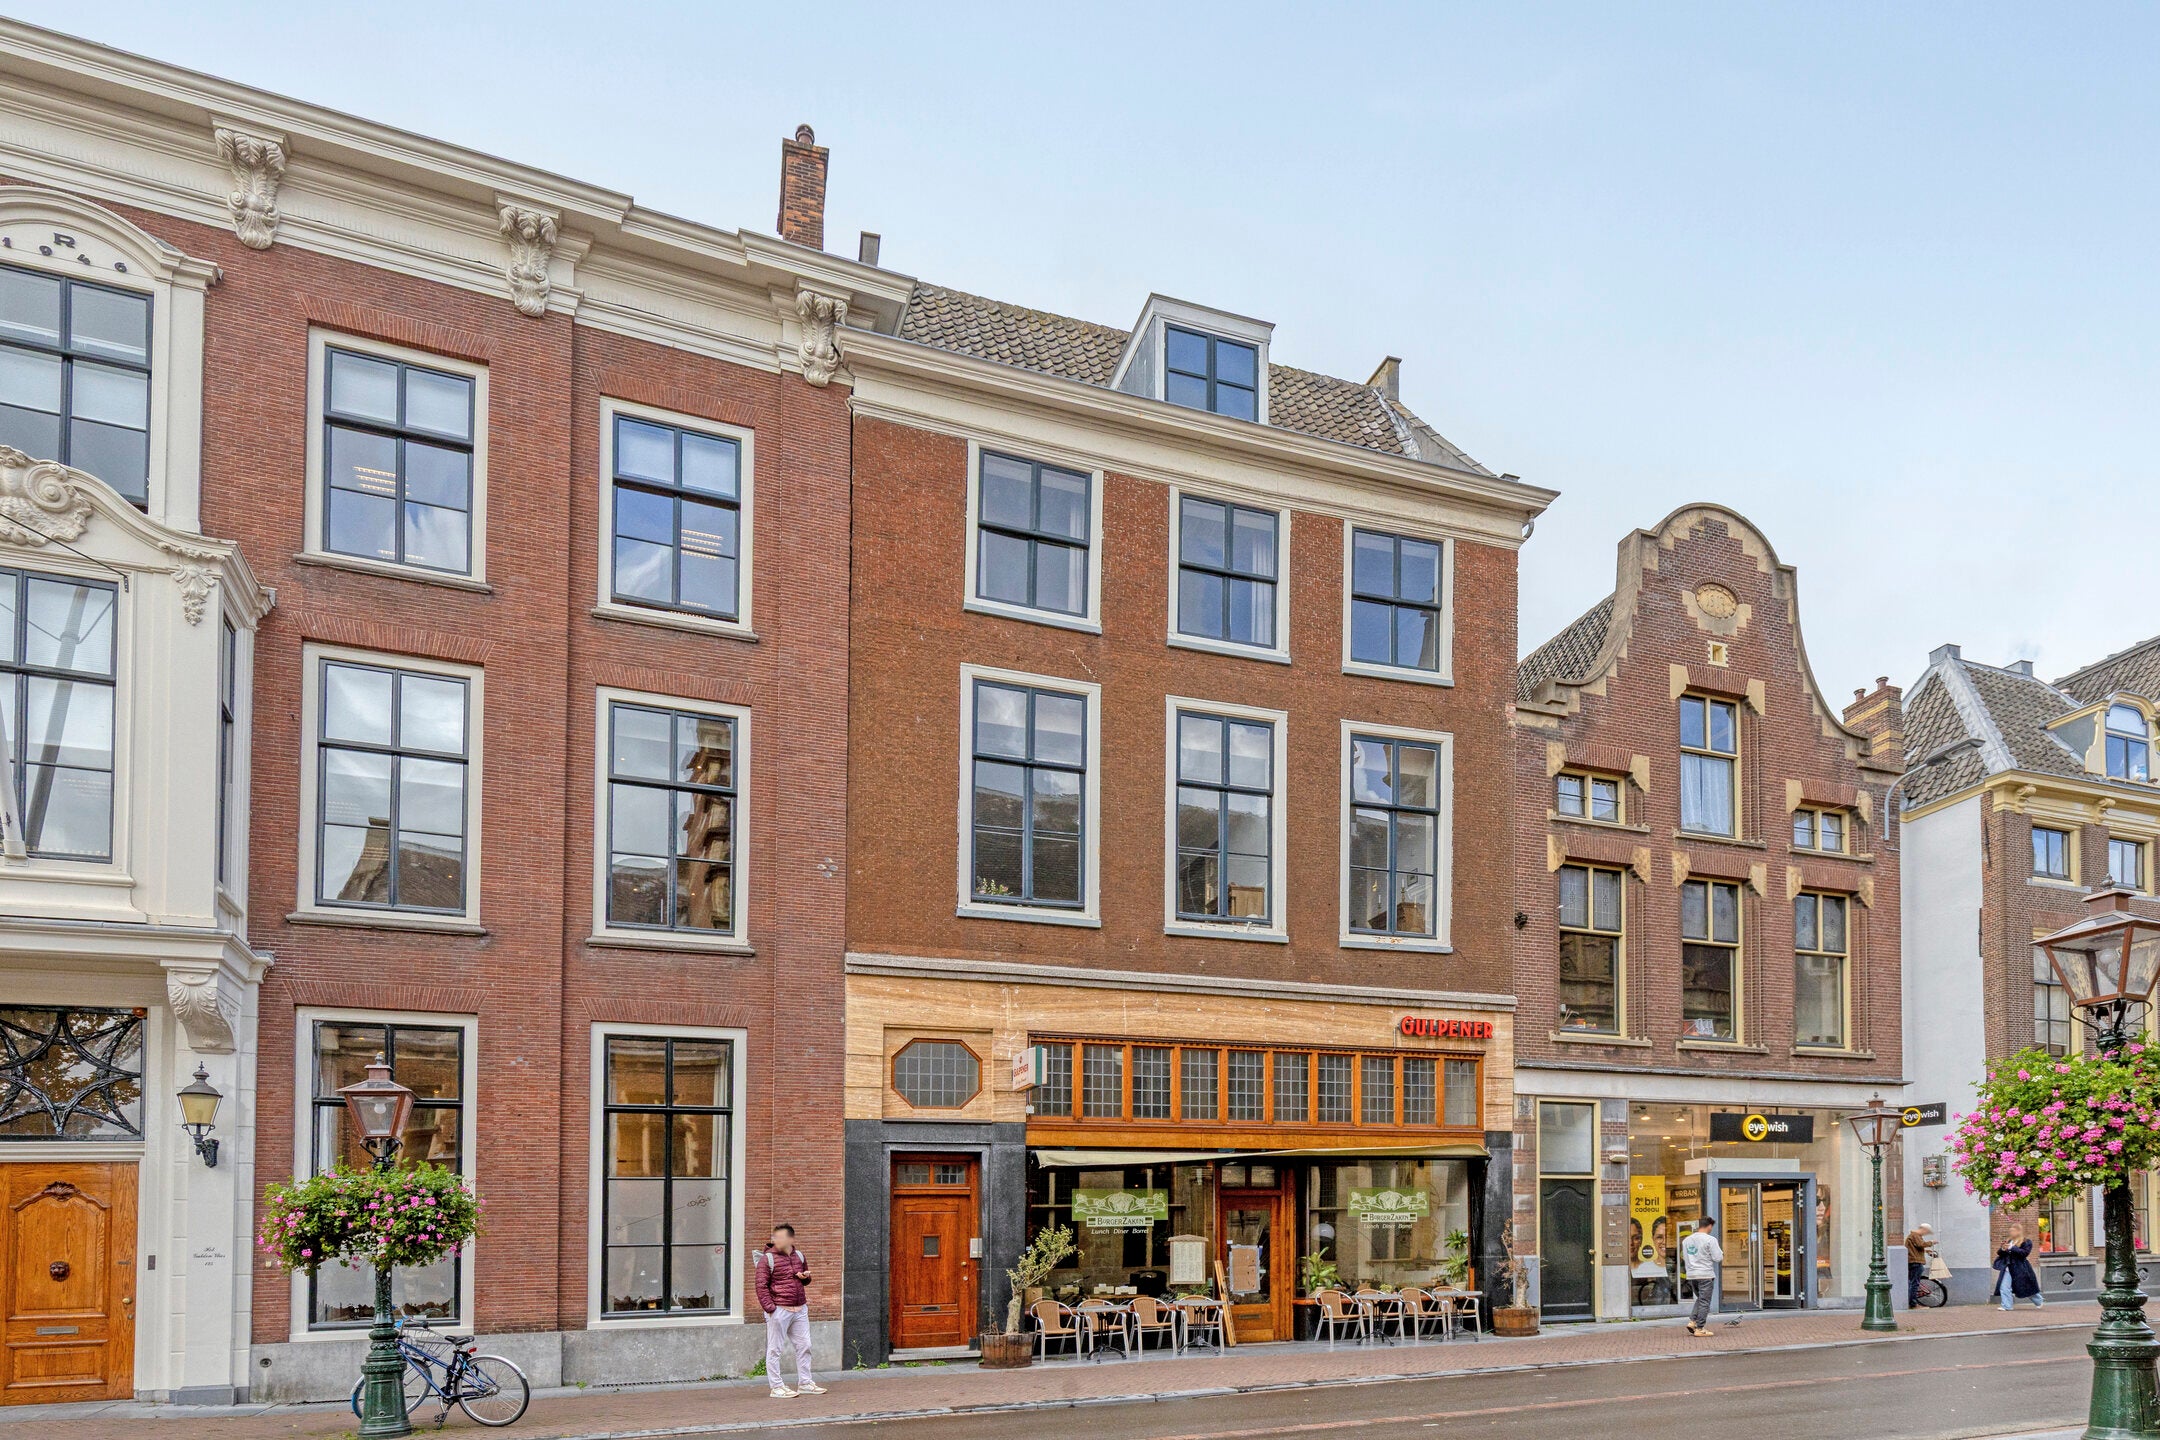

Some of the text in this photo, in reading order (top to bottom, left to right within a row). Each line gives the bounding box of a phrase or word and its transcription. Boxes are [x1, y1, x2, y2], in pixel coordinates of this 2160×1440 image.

[53, 232, 76, 249] R
[1401, 1015, 1494, 1039] GULPENER
[1644, 1196, 1660, 1206] bril
